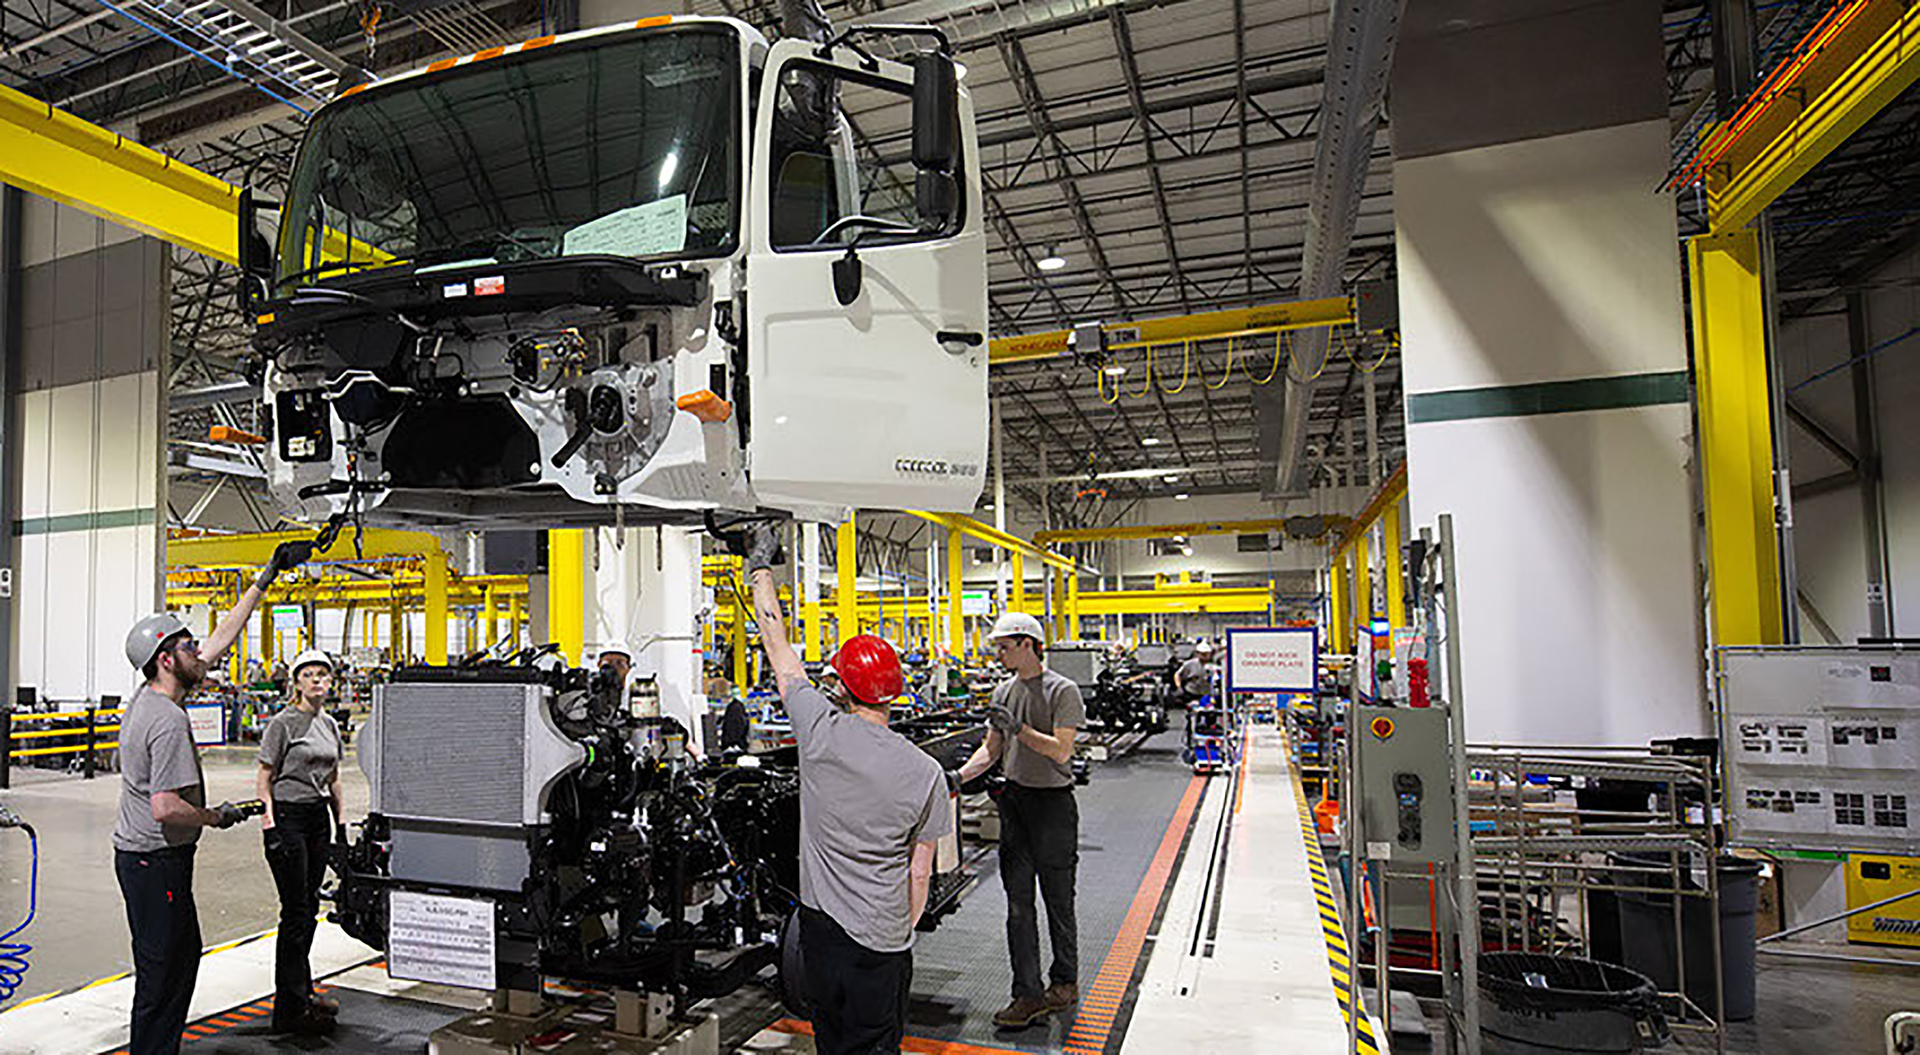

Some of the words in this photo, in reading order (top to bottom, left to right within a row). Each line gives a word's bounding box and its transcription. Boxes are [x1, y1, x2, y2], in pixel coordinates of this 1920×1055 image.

[1244, 650, 1258, 659] DO
[1259, 650, 1276, 659] NOT
[1241, 660, 1277, 668] ORANGE
[1278, 660, 1304, 668] PLATE
